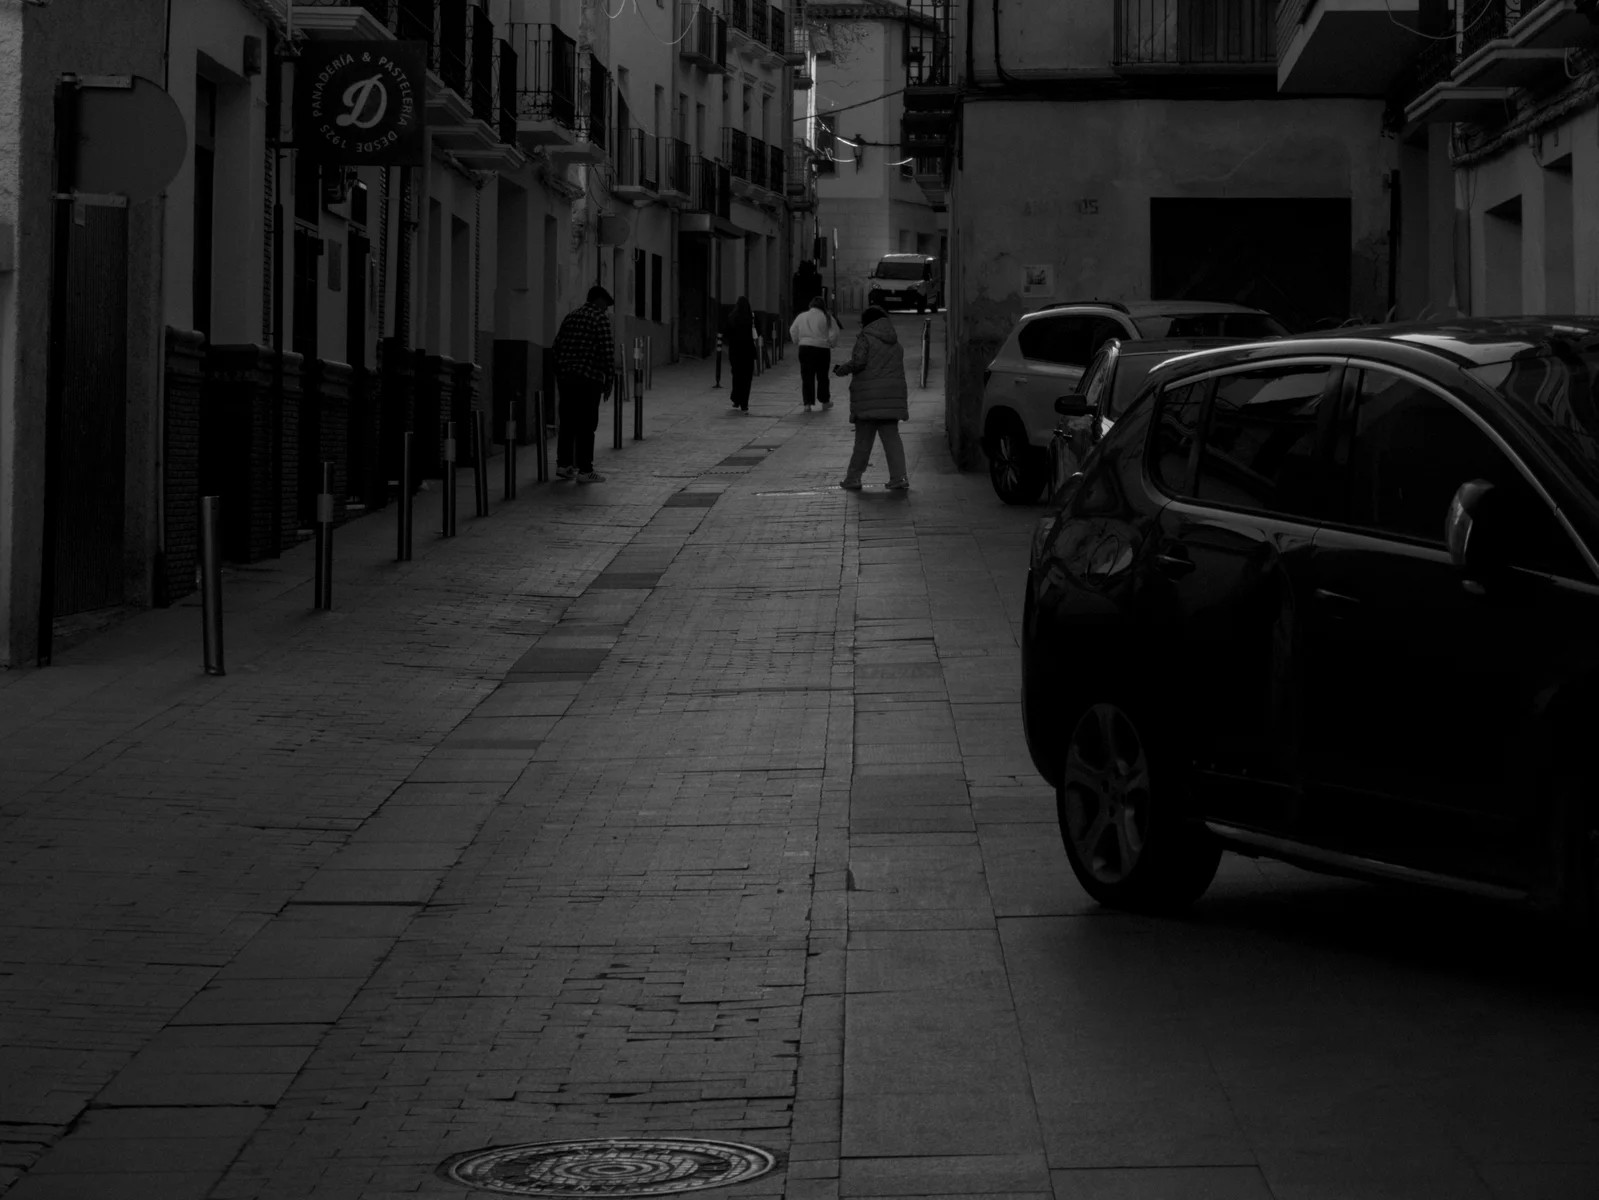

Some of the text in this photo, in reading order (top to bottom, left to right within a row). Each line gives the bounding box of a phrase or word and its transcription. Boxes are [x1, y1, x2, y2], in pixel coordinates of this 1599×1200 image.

[362, 52, 371, 62] &
[320, 124, 398, 153] DESDE 1925
